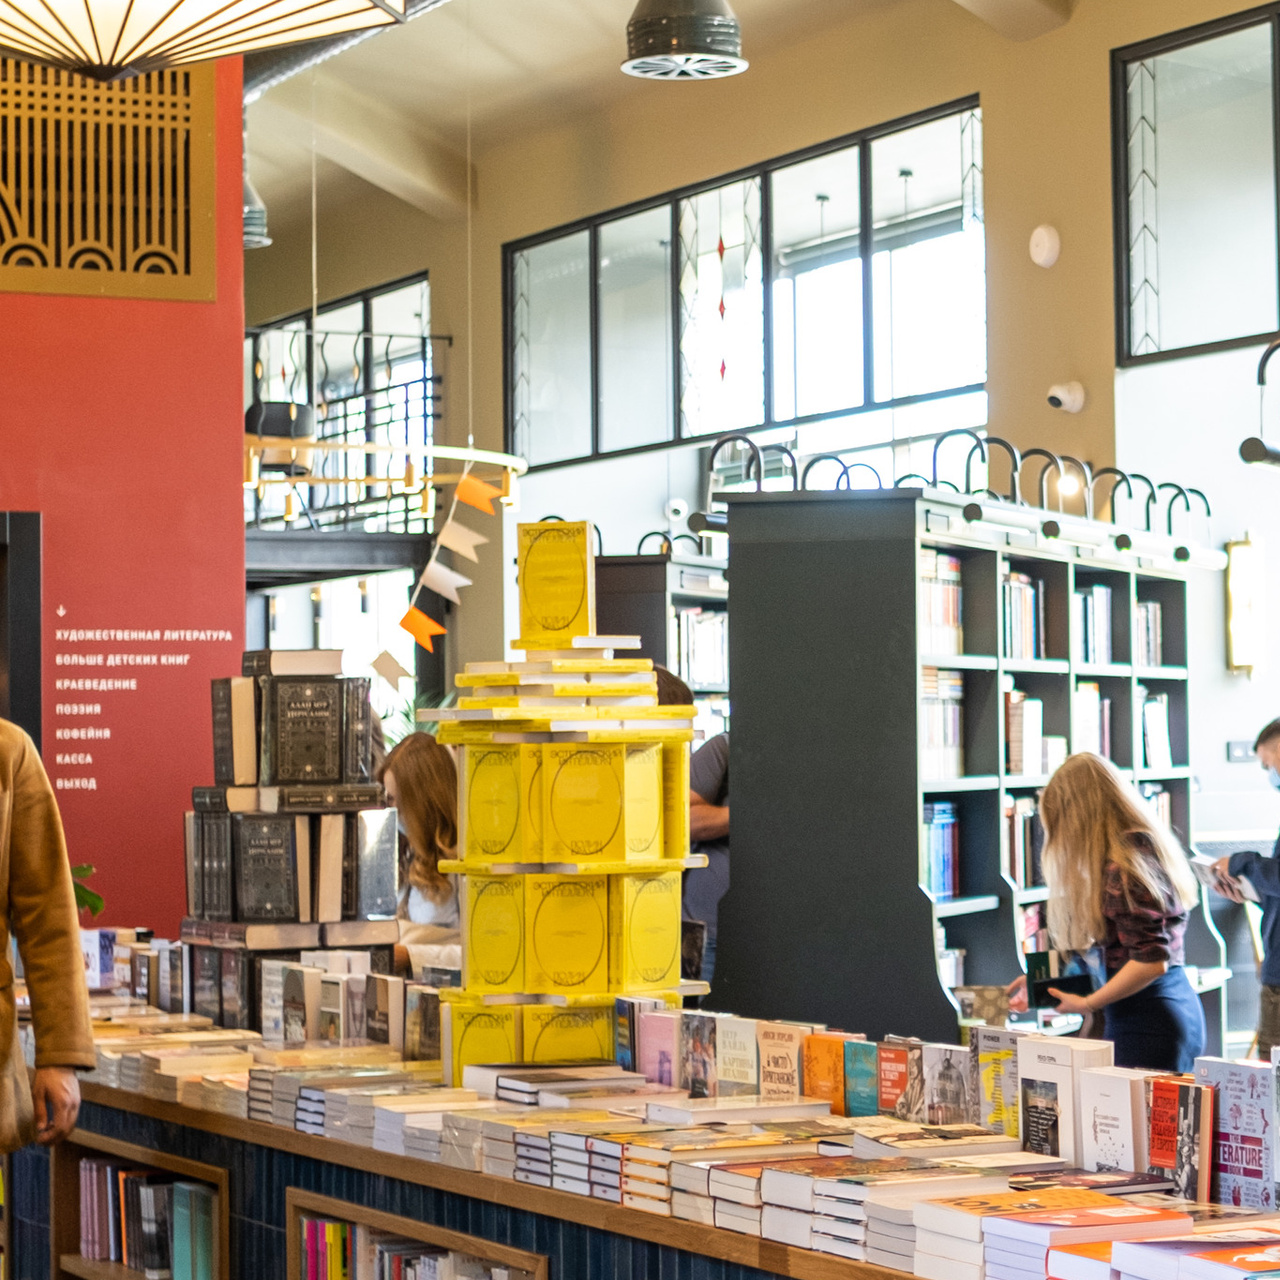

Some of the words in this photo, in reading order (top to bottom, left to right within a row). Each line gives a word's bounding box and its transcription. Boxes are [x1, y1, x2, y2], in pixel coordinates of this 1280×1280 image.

[56, 629, 161, 641] ХУДОЖЕСТВЕННАЯ
[164, 630, 232, 641] ЛИТЕРАТУРА
[56, 654, 103, 665] БОЛЬШЕ
[107, 654, 157, 666] ДЕТСКИХ
[161, 655, 190, 665] КНИГ
[56, 679, 137, 691] КРАЕВЕДЕНИЕ
[56, 704, 101, 715] ПОЭЗИЯ
[56, 727, 111, 739] КОФЕЙНЯ
[56, 753, 93, 764] КАССА
[56, 778, 96, 790] ВЫХОД
